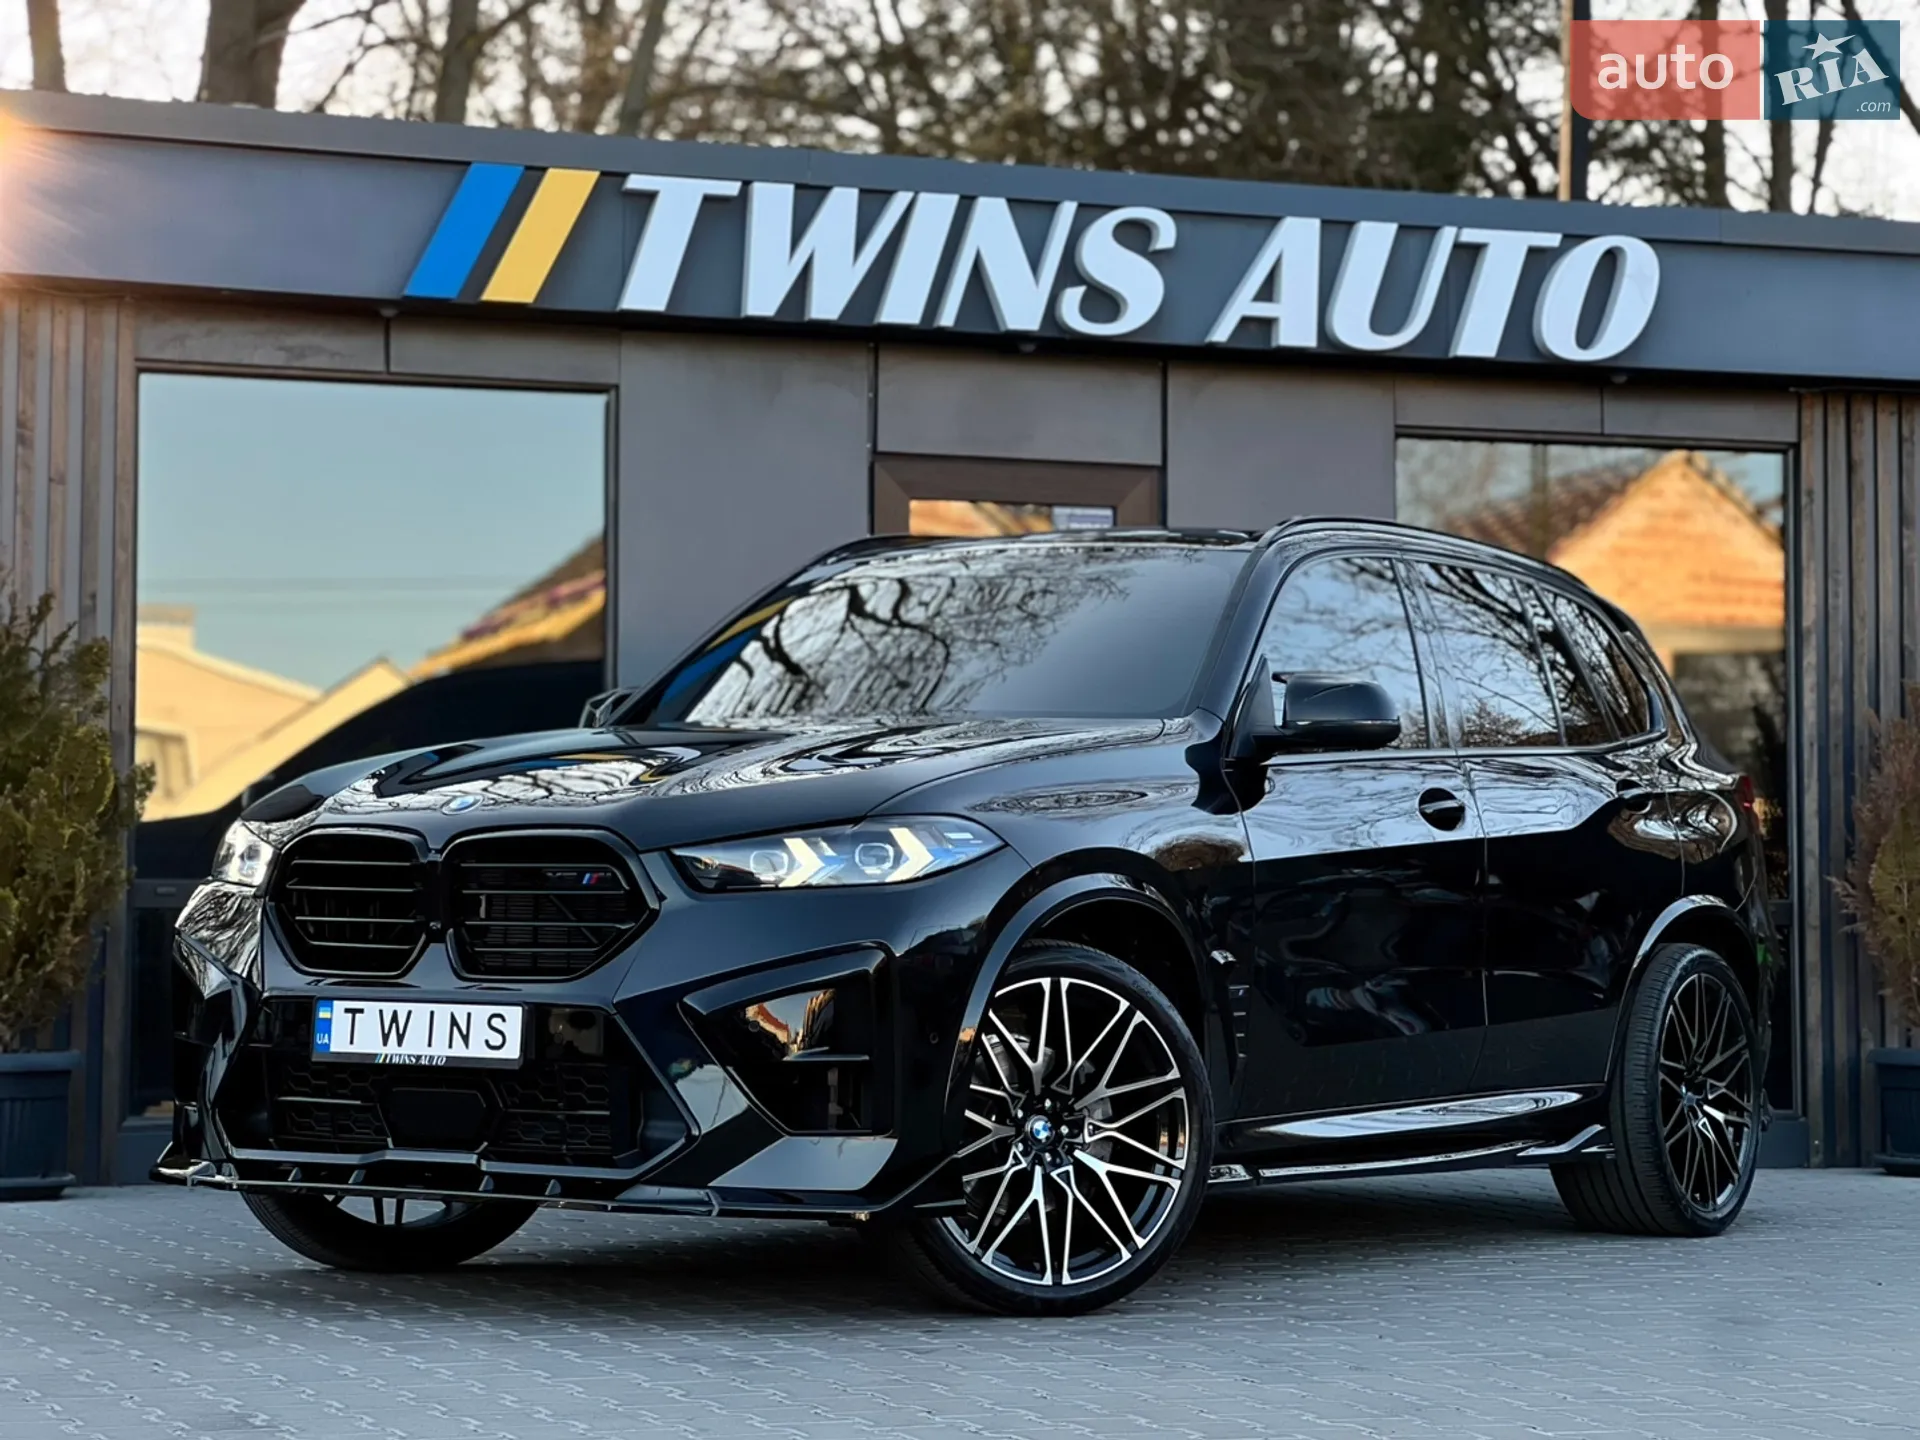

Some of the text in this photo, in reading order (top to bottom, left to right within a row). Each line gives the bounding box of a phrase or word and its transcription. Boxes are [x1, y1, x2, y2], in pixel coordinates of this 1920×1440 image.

[617, 173, 1660, 361] TWINS AUTO
[316, 1033, 329, 1044] UA
[344, 1007, 507, 1051] TWINS
[385, 1053, 447, 1066] TWINS AUTO
